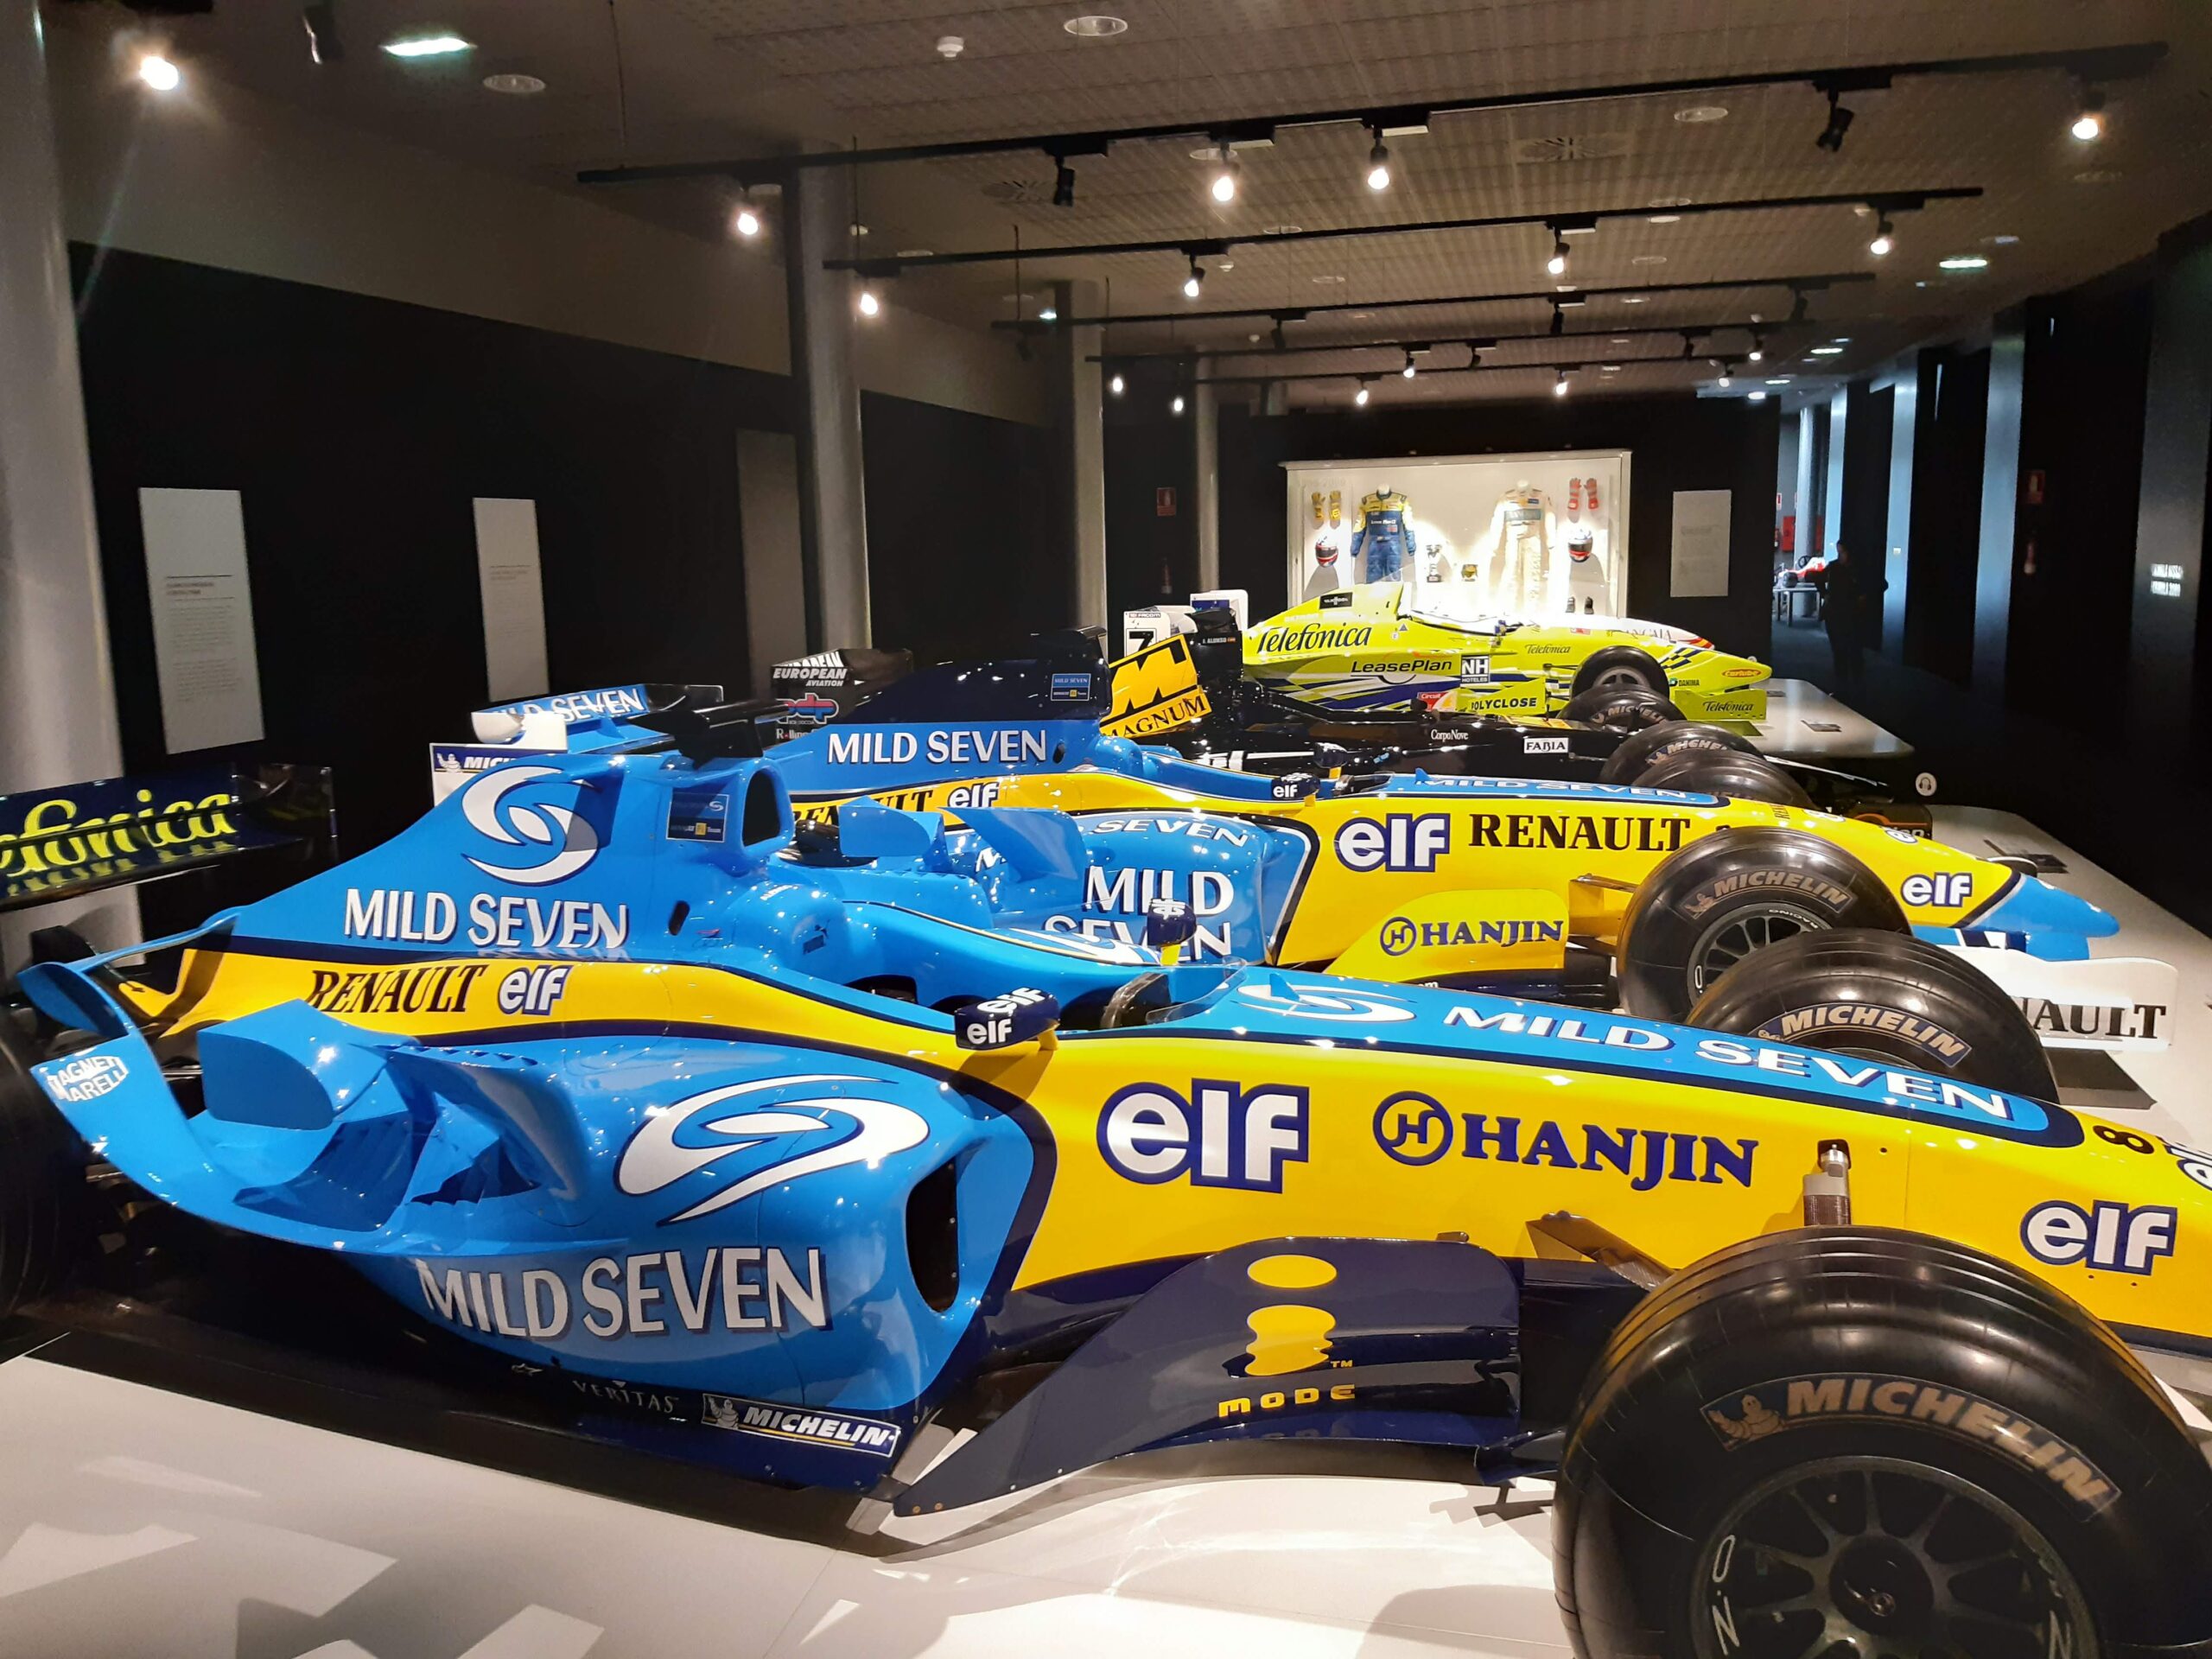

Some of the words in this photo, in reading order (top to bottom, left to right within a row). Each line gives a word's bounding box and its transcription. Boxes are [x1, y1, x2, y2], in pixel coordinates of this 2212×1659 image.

[1128, 631, 1154, 653] 7
[772, 668, 848, 679] EUROPEAN
[1351, 660, 1452, 673] LeasePlan
[1461, 658, 1489, 675] NH
[551, 688, 645, 723] SEVEN
[1471, 697, 1537, 711] POLYCLOSE
[827, 732, 918, 764] MILD
[927, 729, 1046, 763] SEVEN
[1526, 741, 1566, 753] FABIA
[947, 783, 1000, 808] elf
[1273, 785, 1299, 798] elf
[1415, 779, 1528, 788] MILD
[1536, 782, 1687, 799] SEVEN
[1094, 819, 1249, 848] SEVEN
[1337, 814, 1449, 871] elf
[1469, 814, 1691, 852] RENAULT
[1084, 865, 1235, 916] MILD
[1713, 871, 1848, 906] MICHELIN
[1901, 873, 1972, 907] elf
[344, 888, 459, 942] MILD
[467, 893, 629, 949] SEVEN
[1420, 919, 1565, 948] HANJIN
[306, 964, 490, 1014] RENAULT
[498, 964, 574, 1016] elf
[976, 987, 1046, 1014] elf
[967, 1018, 1013, 1045] elf
[1782, 1005, 1967, 1059] MICHELIN
[1442, 1006, 1672, 1052] MILD
[1698, 1039, 2013, 1121] SEVEN
[1097, 1078, 1308, 1192] elf
[1462, 1112, 1759, 1192] HANJIN
[2092, 1125, 2155, 1154] 8
[2021, 1200, 2177, 1274] elf
[415, 1258, 570, 1338] MILD
[582, 1247, 829, 1338] SEVEN
[572, 1379, 680, 1414] VERITAS
[742, 1406, 892, 1446] MICHELIN
[1786, 1377, 2110, 1503] MICHELIN
